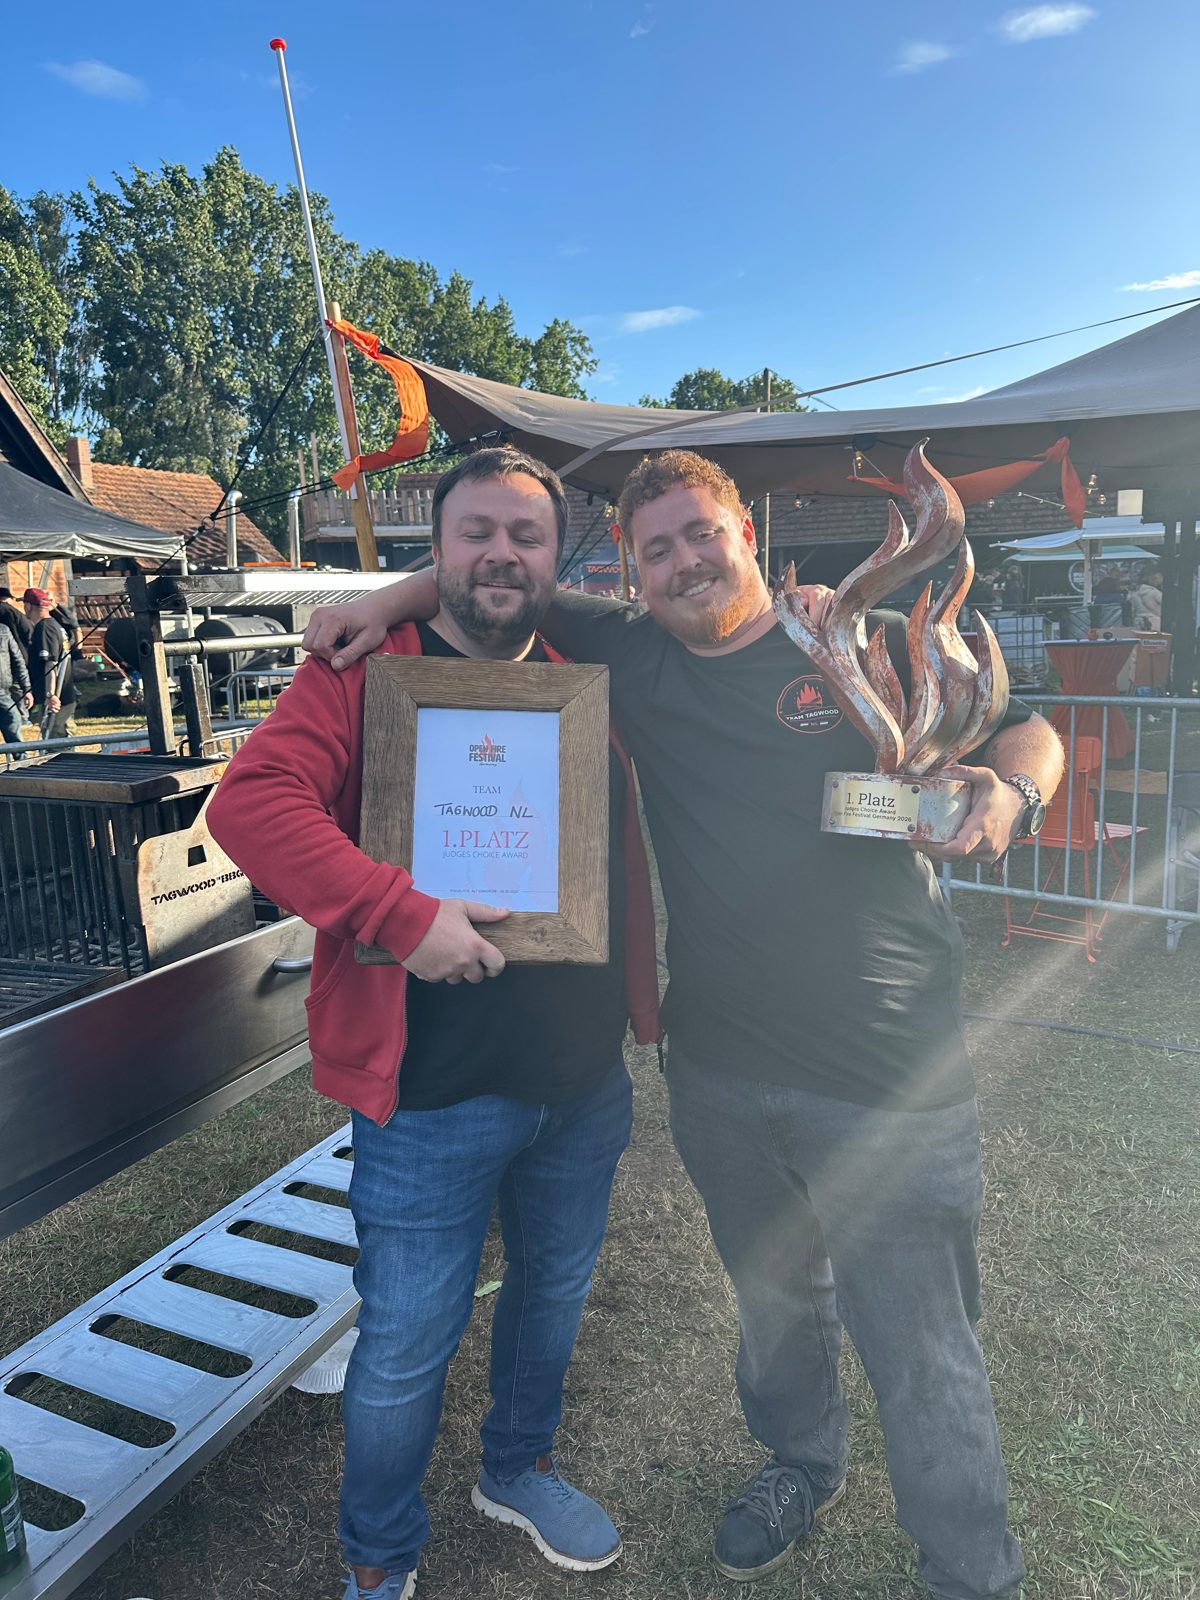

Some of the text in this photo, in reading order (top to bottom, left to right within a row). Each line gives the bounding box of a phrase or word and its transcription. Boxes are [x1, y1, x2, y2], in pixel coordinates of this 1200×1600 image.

[805, 709, 839, 718] TAGWOOD
[469, 745, 506, 753] OPEN FIRE
[469, 753, 506, 762] FESTIVAL
[473, 785, 501, 794] TEAM
[858, 792, 895, 807] Platz
[509, 806, 533, 818] NL
[872, 813, 895, 821] Germany
[442, 850, 528, 859] JUDGES CHOICE AWARD
[150, 878, 216, 905] TAGWOOD
